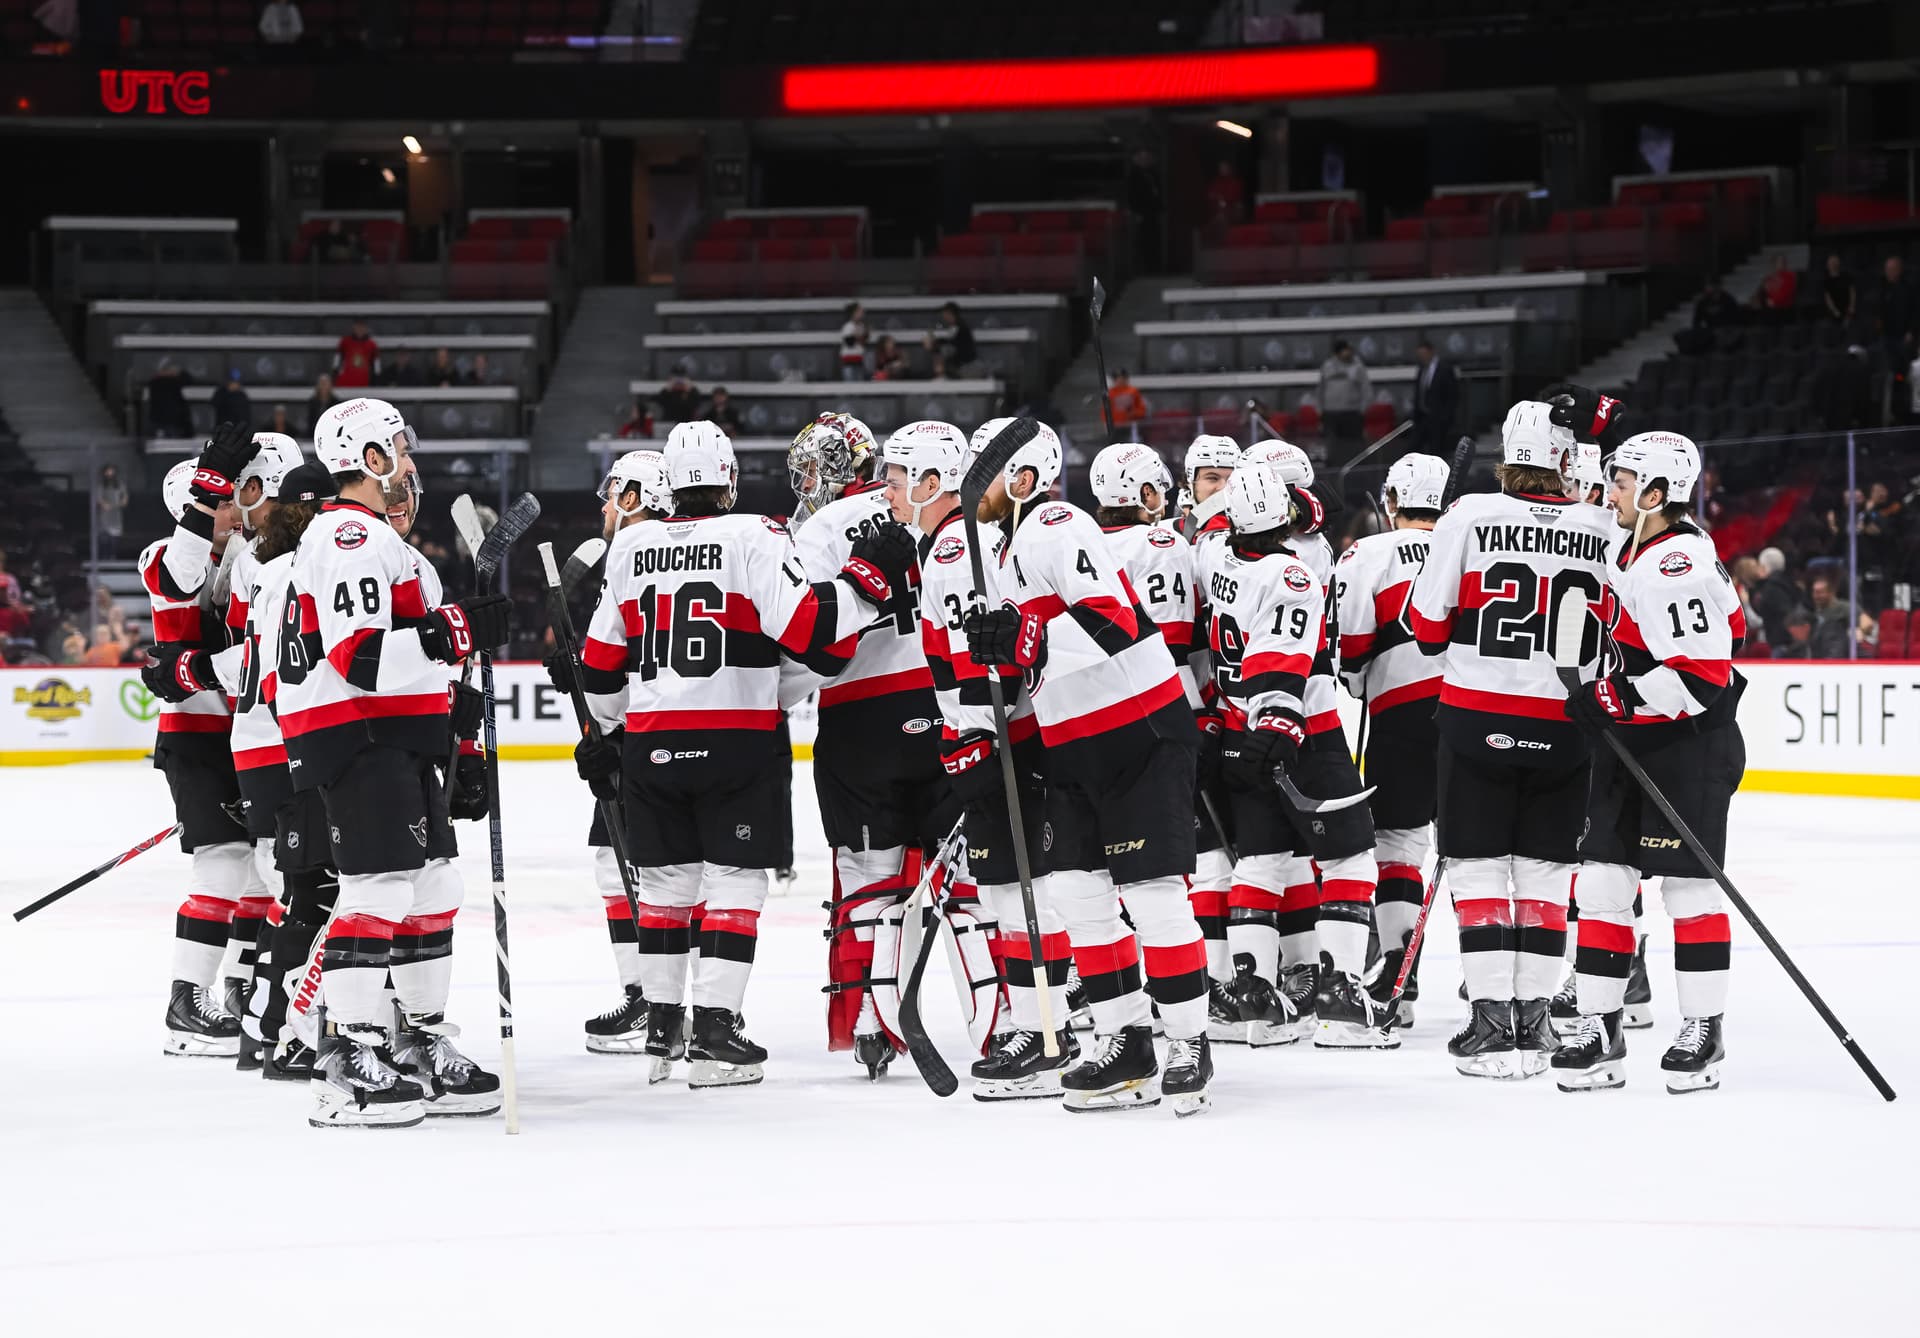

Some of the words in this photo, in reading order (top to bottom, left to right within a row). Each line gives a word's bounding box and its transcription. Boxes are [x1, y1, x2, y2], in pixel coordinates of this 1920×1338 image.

[99, 69, 210, 115] UTC
[1516, 448, 1531, 462] 26
[689, 469, 702, 483] 16
[1095, 474, 1105, 486] 24
[1253, 501, 1266, 514] 19
[1426, 494, 1439, 506] 42
[1529, 506, 1562, 515] CCM
[634, 543, 722, 577] BOUCHER
[1475, 525, 1610, 565] YAKEMCHUK
[1013, 554, 1027, 589] A
[1075, 549, 1099, 581] 4
[334, 577, 380, 618] 48
[1147, 572, 1186, 604] 24
[1211, 571, 1239, 605] REES
[638, 581, 725, 682] 16
[1271, 604, 1309, 640] 19
[1667, 598, 1710, 639] 13
[1256, 716, 1306, 745] CCM
[1517, 740, 1552, 751] CCM
[674, 750, 709, 759] CCM
[1103, 838, 1146, 856] CCM
[1640, 836, 1682, 849] CCM
